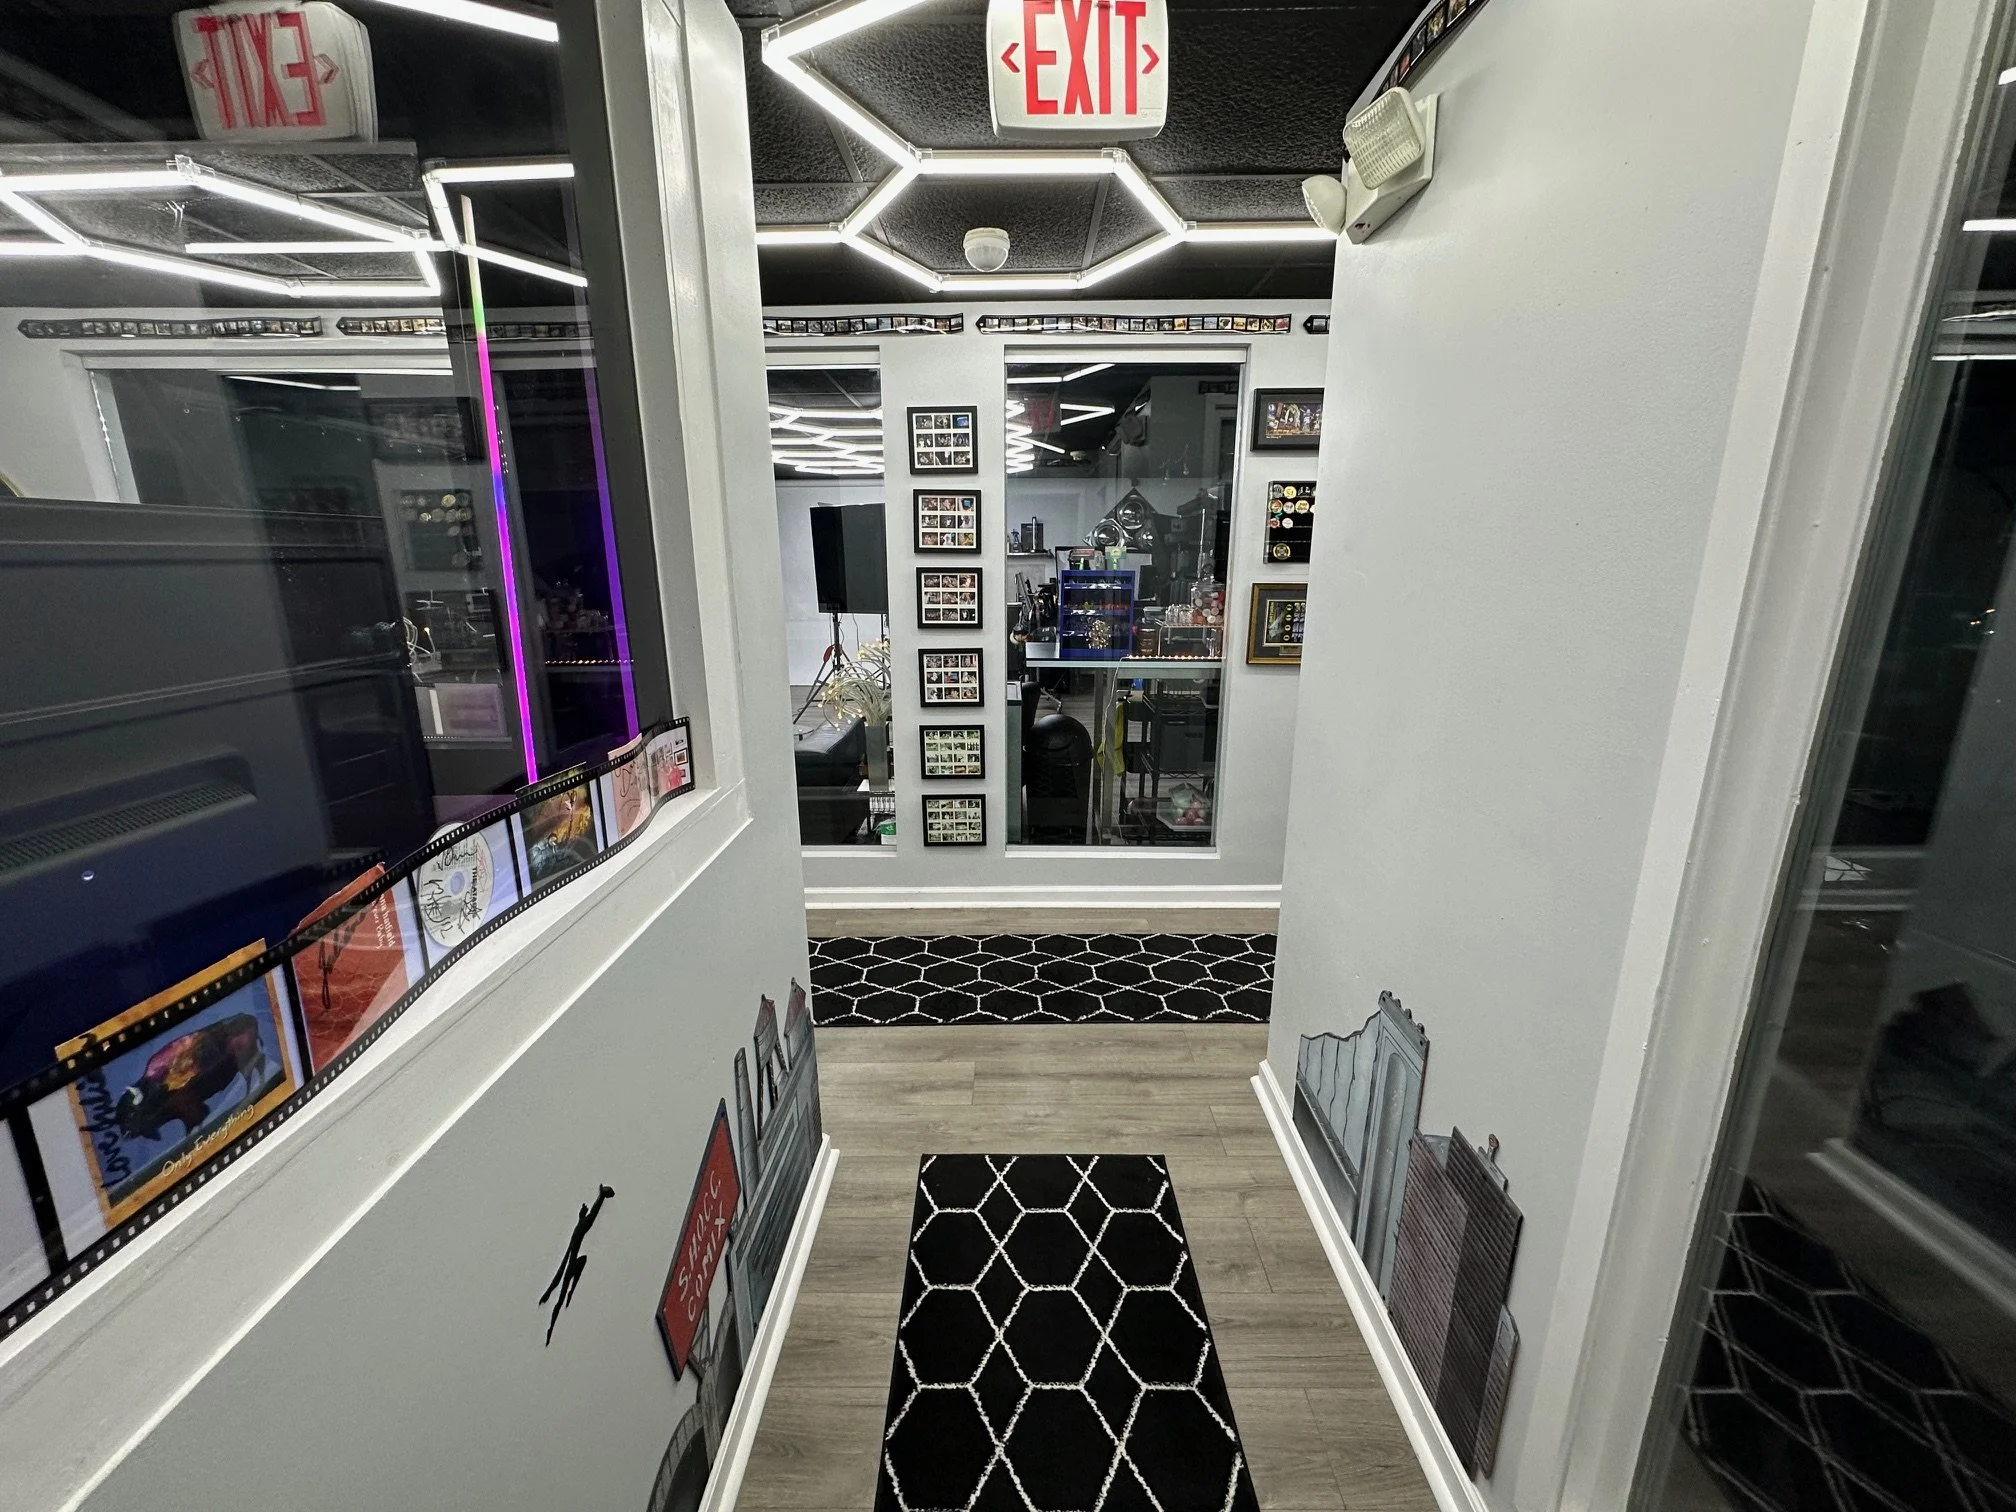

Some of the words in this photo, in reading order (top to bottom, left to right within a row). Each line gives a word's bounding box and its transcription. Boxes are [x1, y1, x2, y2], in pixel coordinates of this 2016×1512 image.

[1023, 0, 1147, 115] EXIT
[162, 1152, 192, 1177] Only
[194, 1104, 254, 1151] Everything
